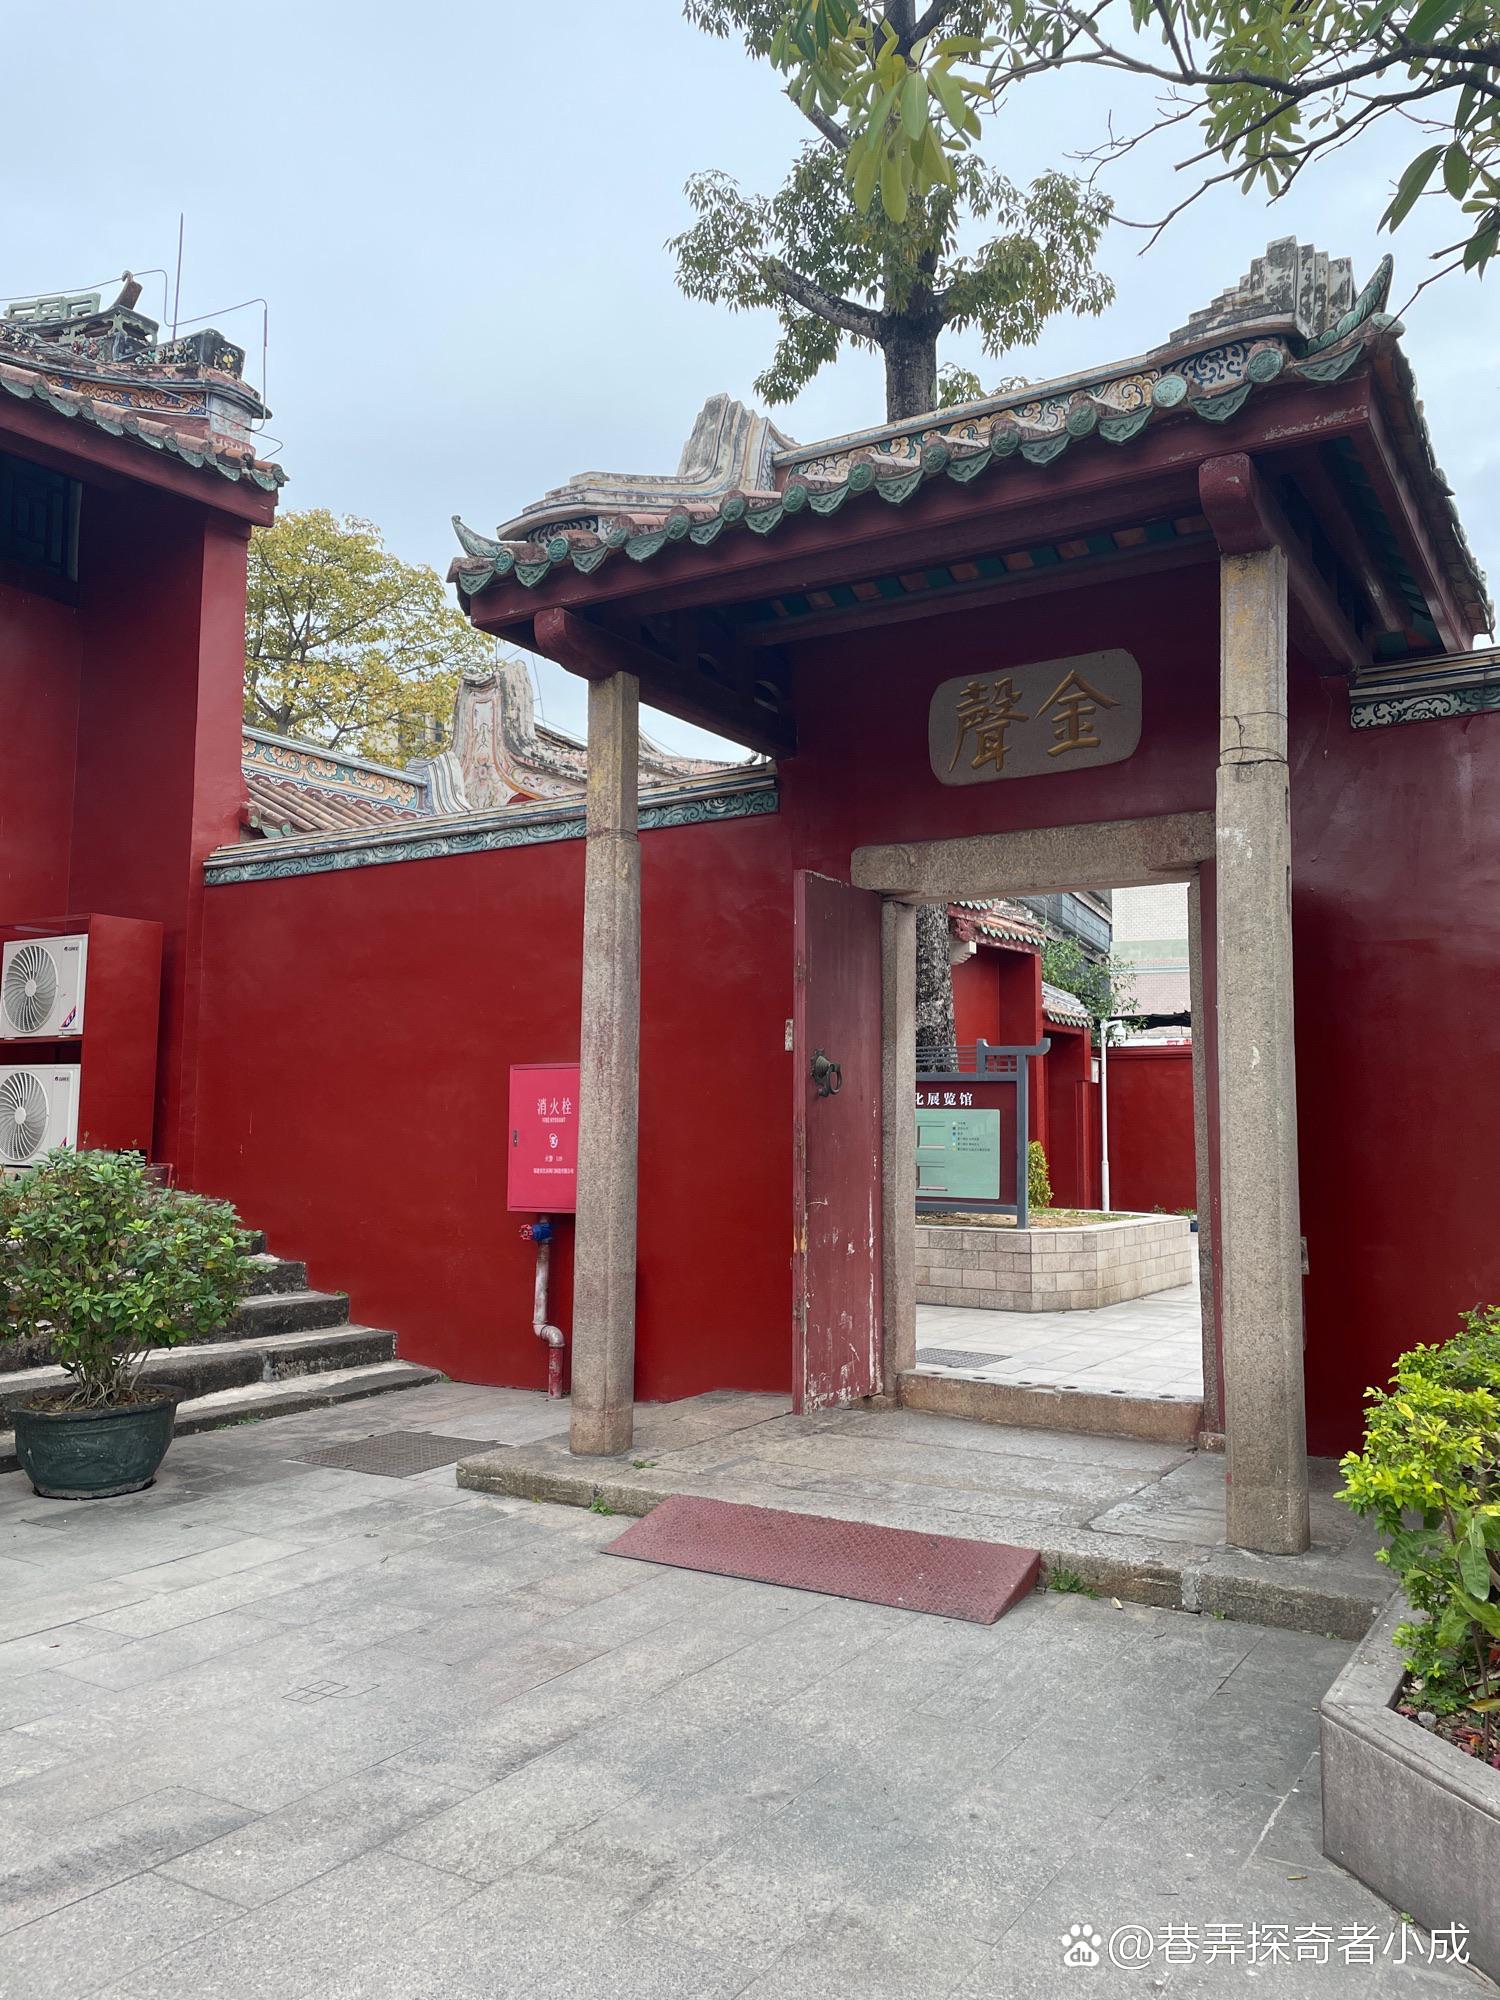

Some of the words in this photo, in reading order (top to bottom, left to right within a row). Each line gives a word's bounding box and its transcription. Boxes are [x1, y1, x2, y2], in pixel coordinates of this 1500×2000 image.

[949, 669, 1121, 773] 金聲
[537, 1097, 572, 1115] 消火栓
